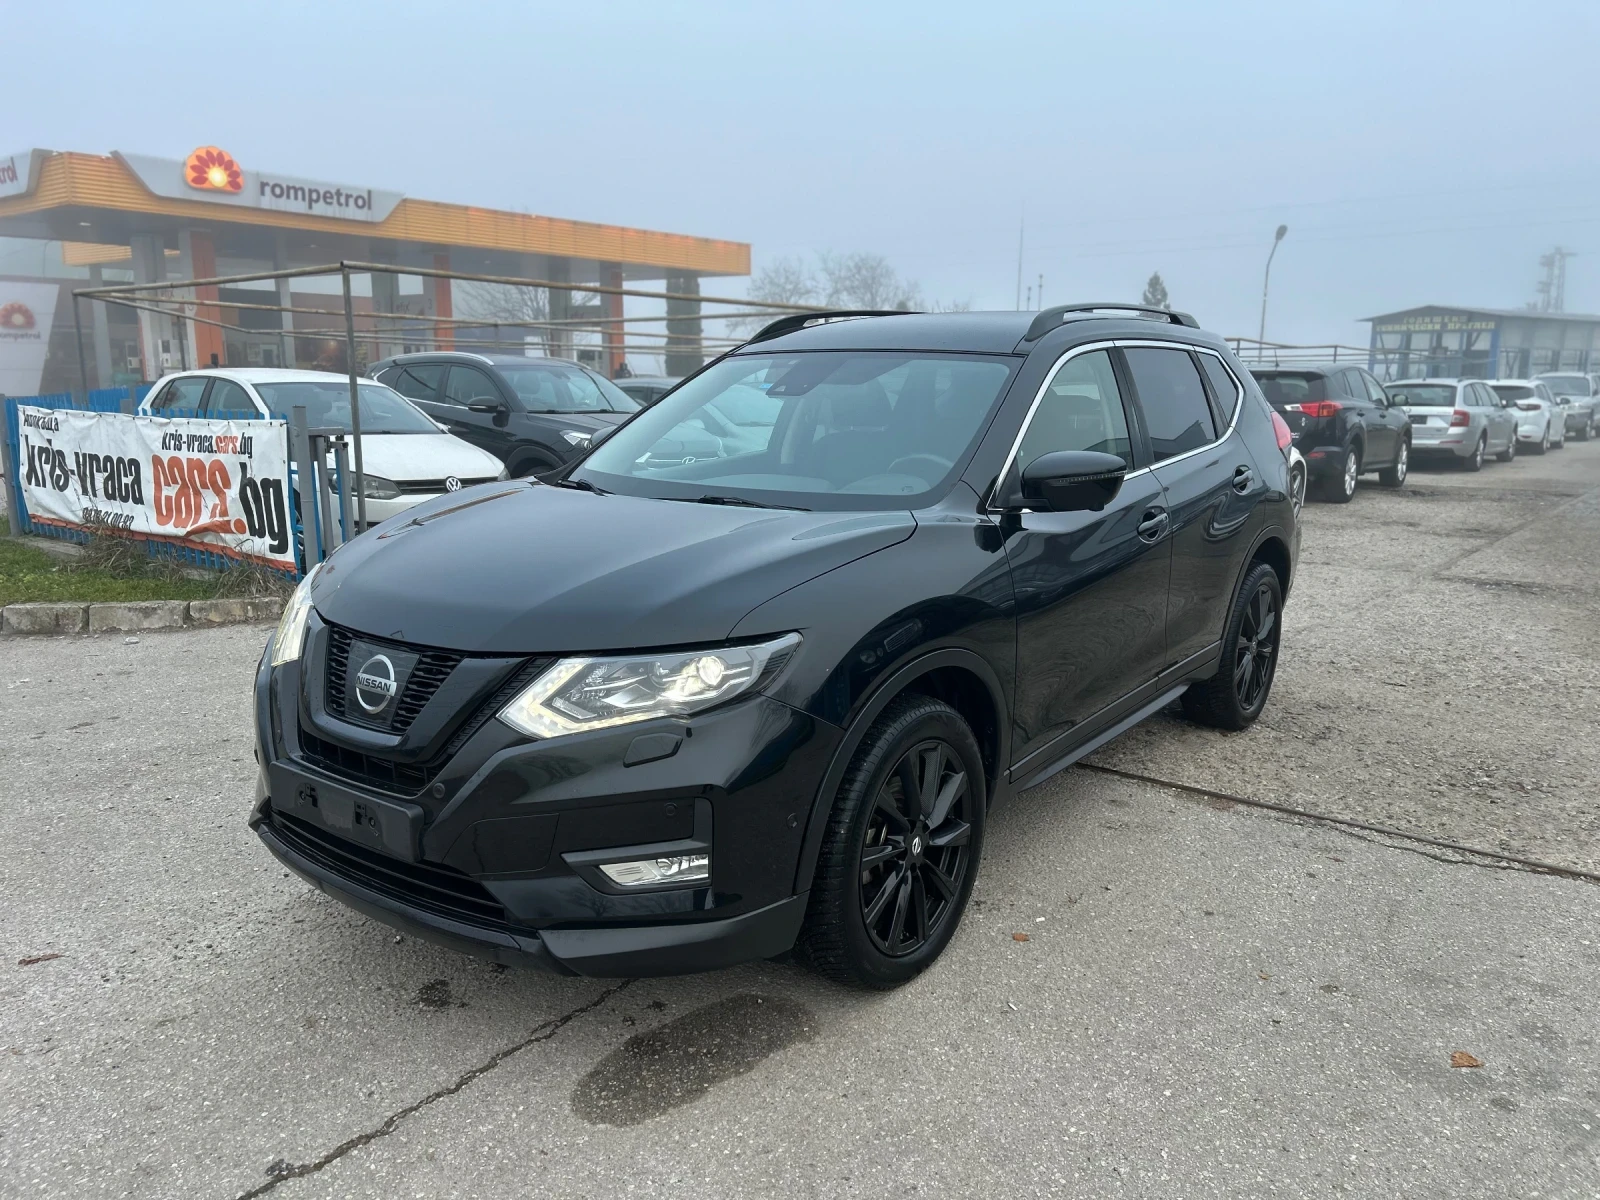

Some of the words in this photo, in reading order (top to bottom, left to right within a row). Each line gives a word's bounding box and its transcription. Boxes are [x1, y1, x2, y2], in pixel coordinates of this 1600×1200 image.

[260, 180, 372, 211] rompetrol
[0, 331, 41, 342] ompetrol
[23, 413, 59, 433] Атокъща
[161, 429, 253, 458] kris-vraca.cars.bg
[25, 434, 145, 505] kris-vraca
[357, 675, 391, 692] NISSAN
